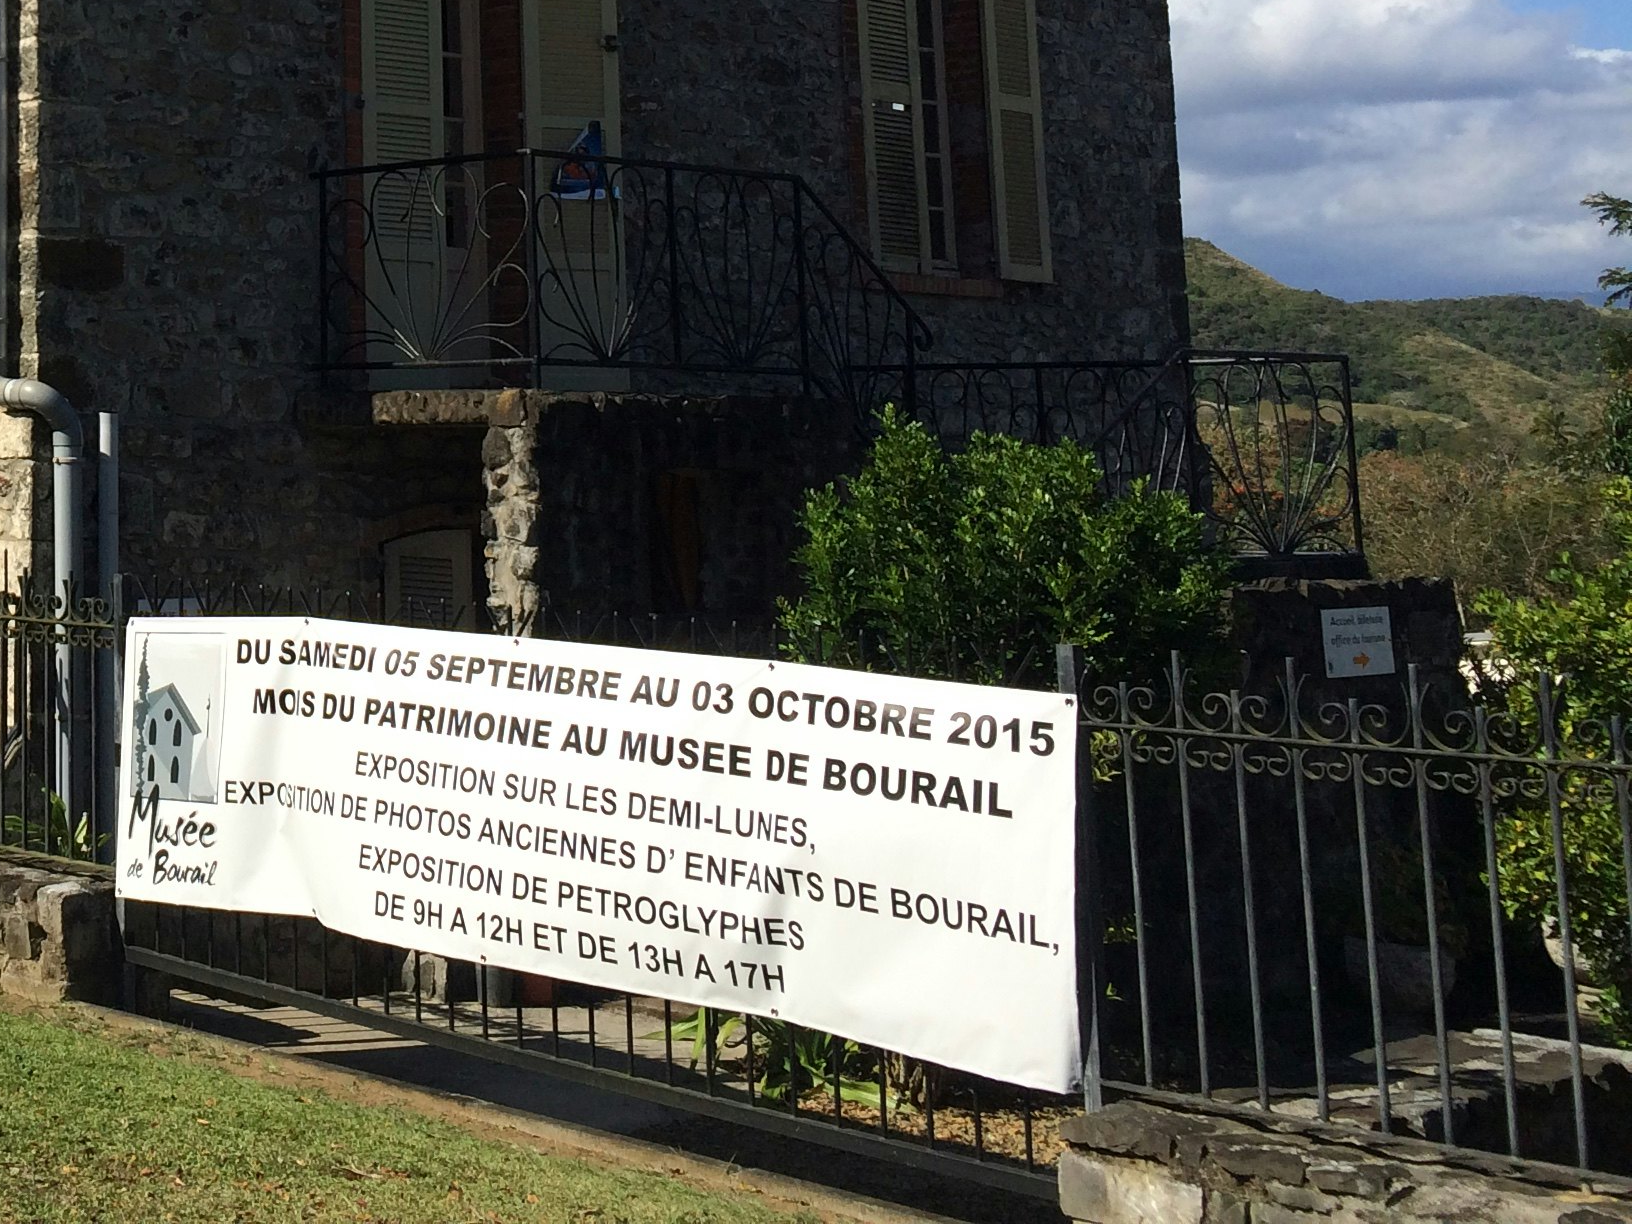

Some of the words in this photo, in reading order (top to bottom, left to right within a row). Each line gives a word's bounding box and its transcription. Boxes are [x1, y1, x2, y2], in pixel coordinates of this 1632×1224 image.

[236, 639, 271, 665] DU
[278, 639, 376, 673] SAMEDI
[383, 649, 420, 677] 05
[426, 654, 622, 701] SEPTEMBRE
[630, 675, 680, 708] AU
[692, 681, 734, 715] 03
[748, 686, 934, 741] OCTOBRE
[947, 712, 1055, 757] 2015
[253, 688, 316, 718] MOIS
[322, 693, 355, 723] DU
[363, 698, 552, 750] PATRIMOINE
[560, 723, 608, 757] AU
[619, 730, 752, 778] MUSEE
[765, 749, 810, 787] DE
[822, 757, 1013, 819] BOURAIL
[355, 751, 495, 796] EXPOSITION
[503, 773, 557, 807] SUR
[565, 782, 617, 816] LES
[628, 792, 816, 855] DEMI-LUNES,
[126, 858, 144, 879] de
[152, 848, 218, 886] Bourail
[128, 783, 217, 860] Musée
[225, 780, 335, 816] EXPOSITION
[340, 793, 368, 822] DE
[374, 799, 471, 840] PHOTOS
[477, 817, 636, 869] ANCIENNES
[685, 851, 825, 902] ENFANTS
[834, 877, 879, 914] DE
[890, 887, 1060, 956] BOURAIL,
[359, 844, 503, 896] EXPOSITION
[512, 872, 548, 905] DE
[558, 881, 805, 951] PETROGLYPHES
[374, 890, 406, 921] DE
[413, 898, 443, 930] 9H
[450, 907, 468, 935] A
[476, 912, 523, 946] 12H
[533, 922, 568, 954] ET
[577, 931, 618, 965] DE
[628, 941, 684, 977] 13H
[694, 953, 717, 984] A
[724, 959, 785, 993] 17H
